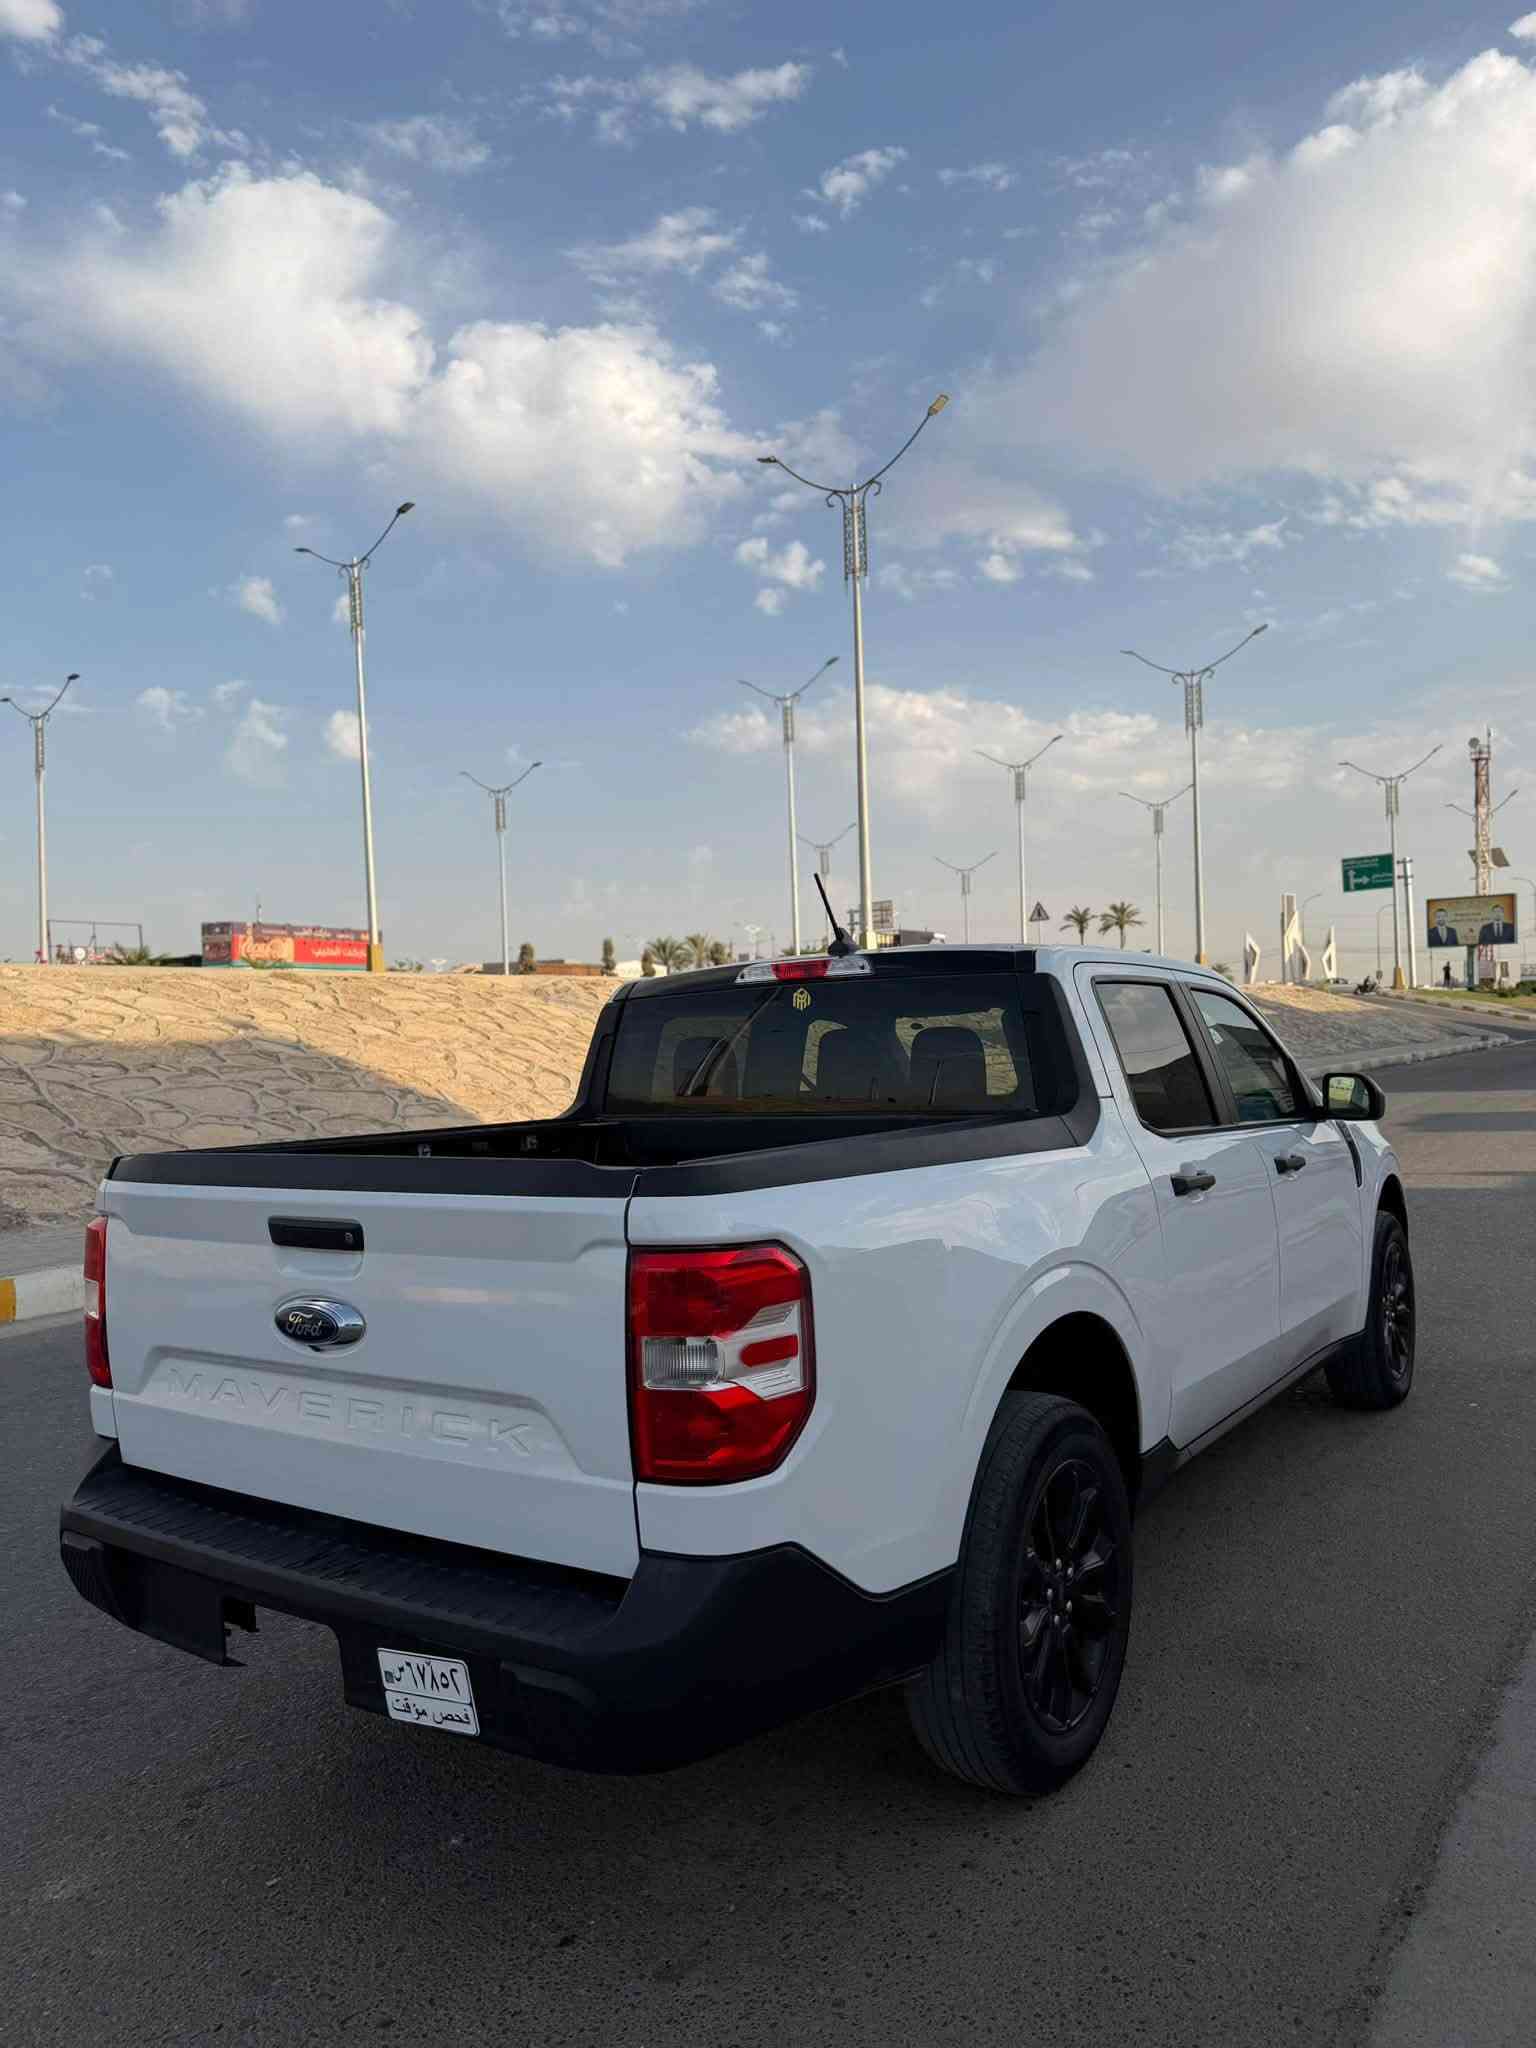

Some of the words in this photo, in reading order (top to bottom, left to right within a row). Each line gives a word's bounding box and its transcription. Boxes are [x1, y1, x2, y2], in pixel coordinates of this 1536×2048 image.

[287, 1311, 322, 1337] Ford
[168, 1367, 531, 1457] MAVERICK
[405, 1661, 461, 1697] ٦٧٨٥٢
[432, 1708, 471, 1725] فحص
